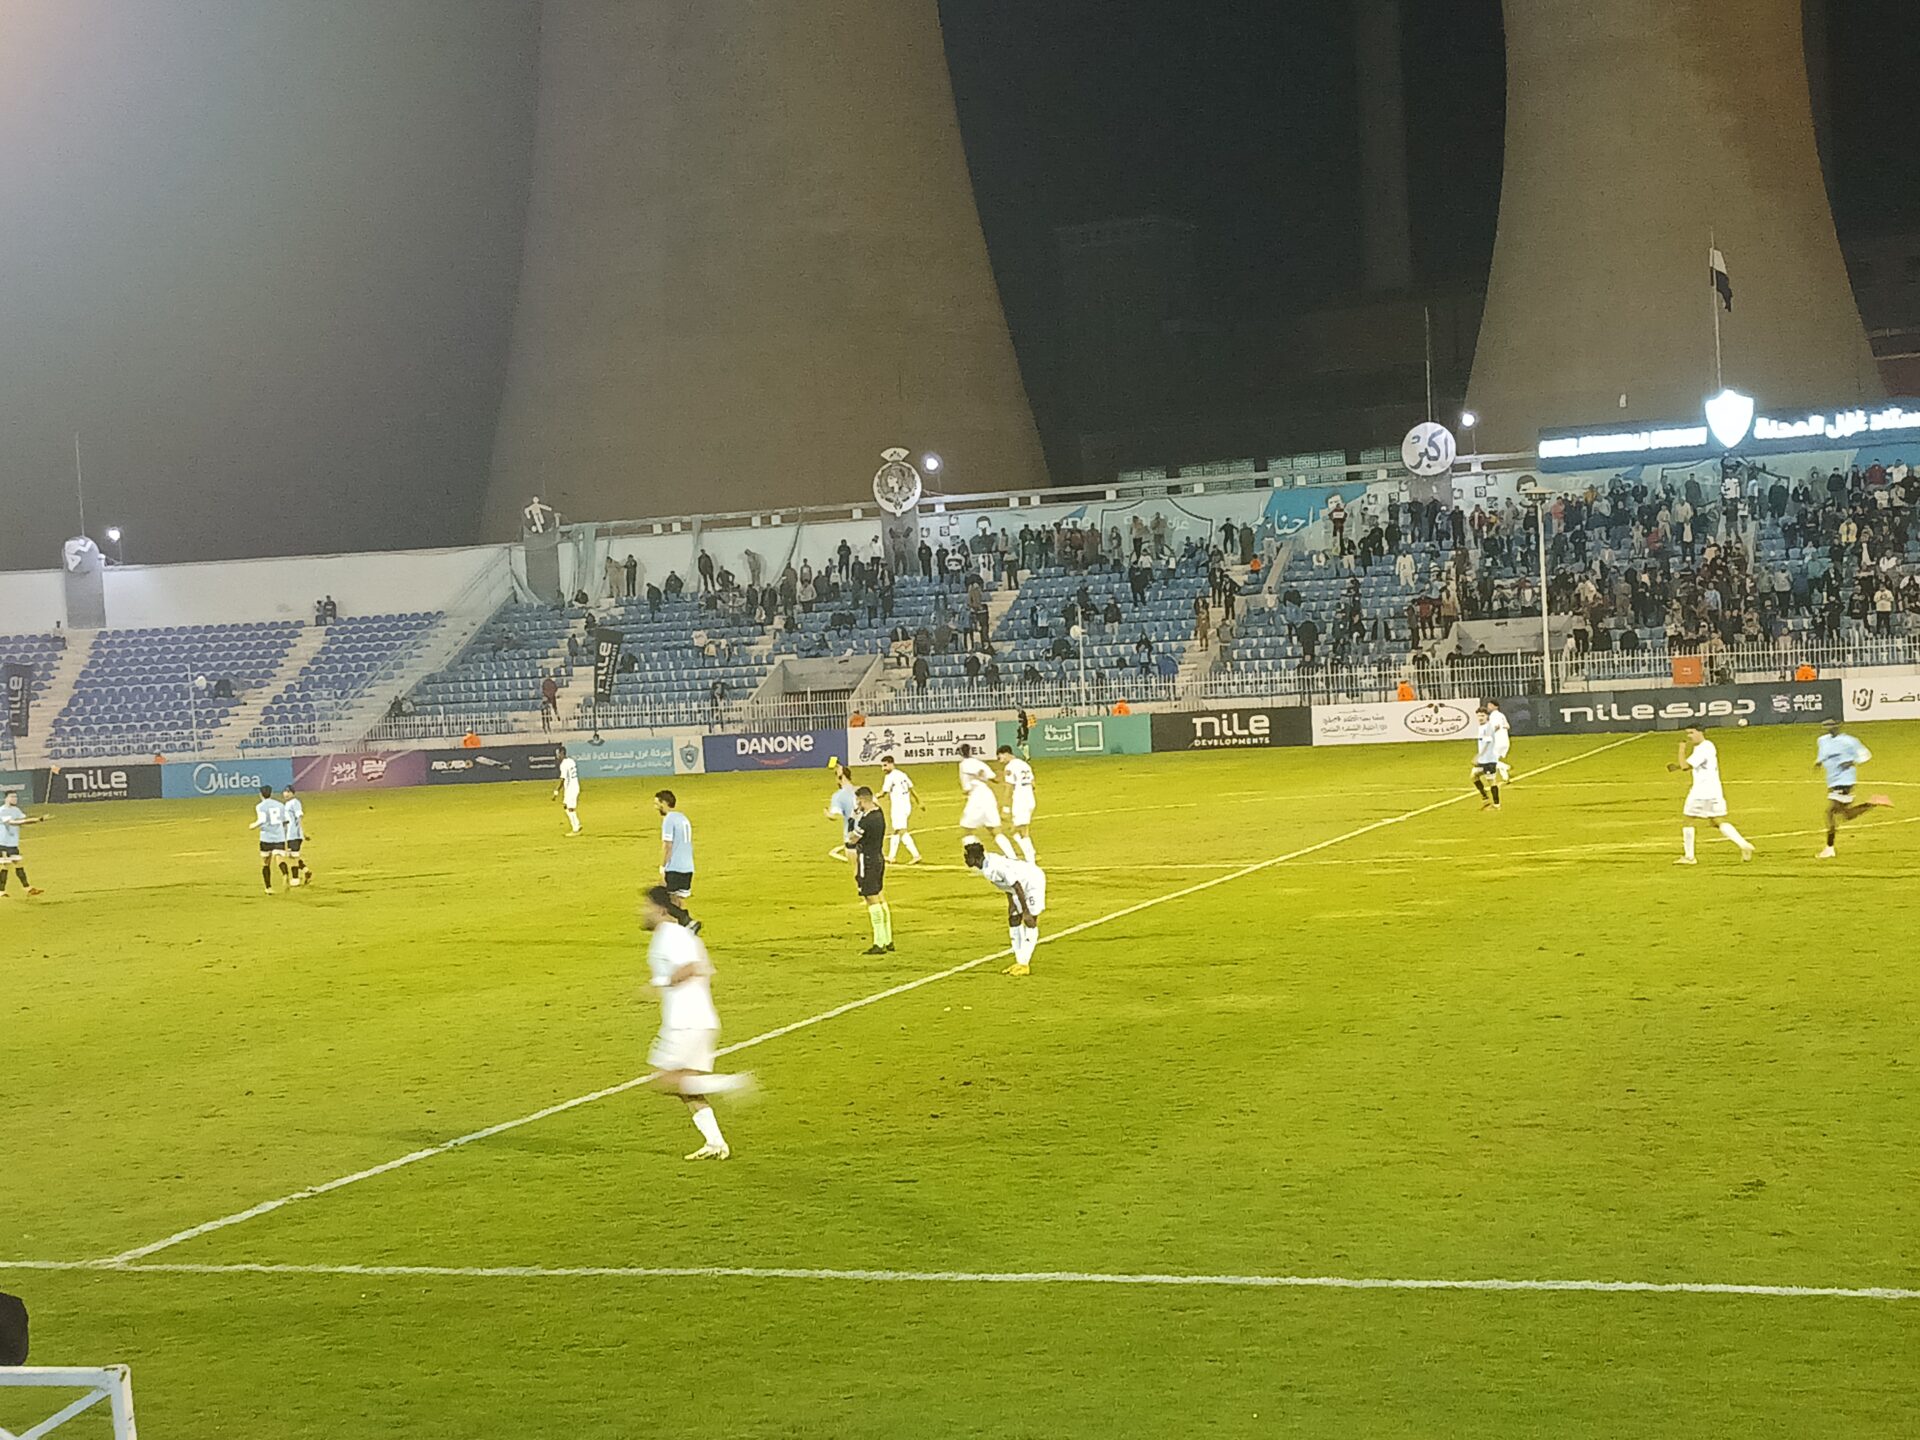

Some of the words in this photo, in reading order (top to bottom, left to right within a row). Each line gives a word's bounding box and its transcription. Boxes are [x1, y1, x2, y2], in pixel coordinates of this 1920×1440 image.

[904, 730, 953, 746] للسياحة
[1194, 737, 1270, 747] DEVELOPMENTS
[904, 748, 934, 758] MISR
[938, 746, 986, 757] TRAEL
[205, 772, 261, 790] Midea
[67, 790, 127, 799] DEVELOPMENTS
